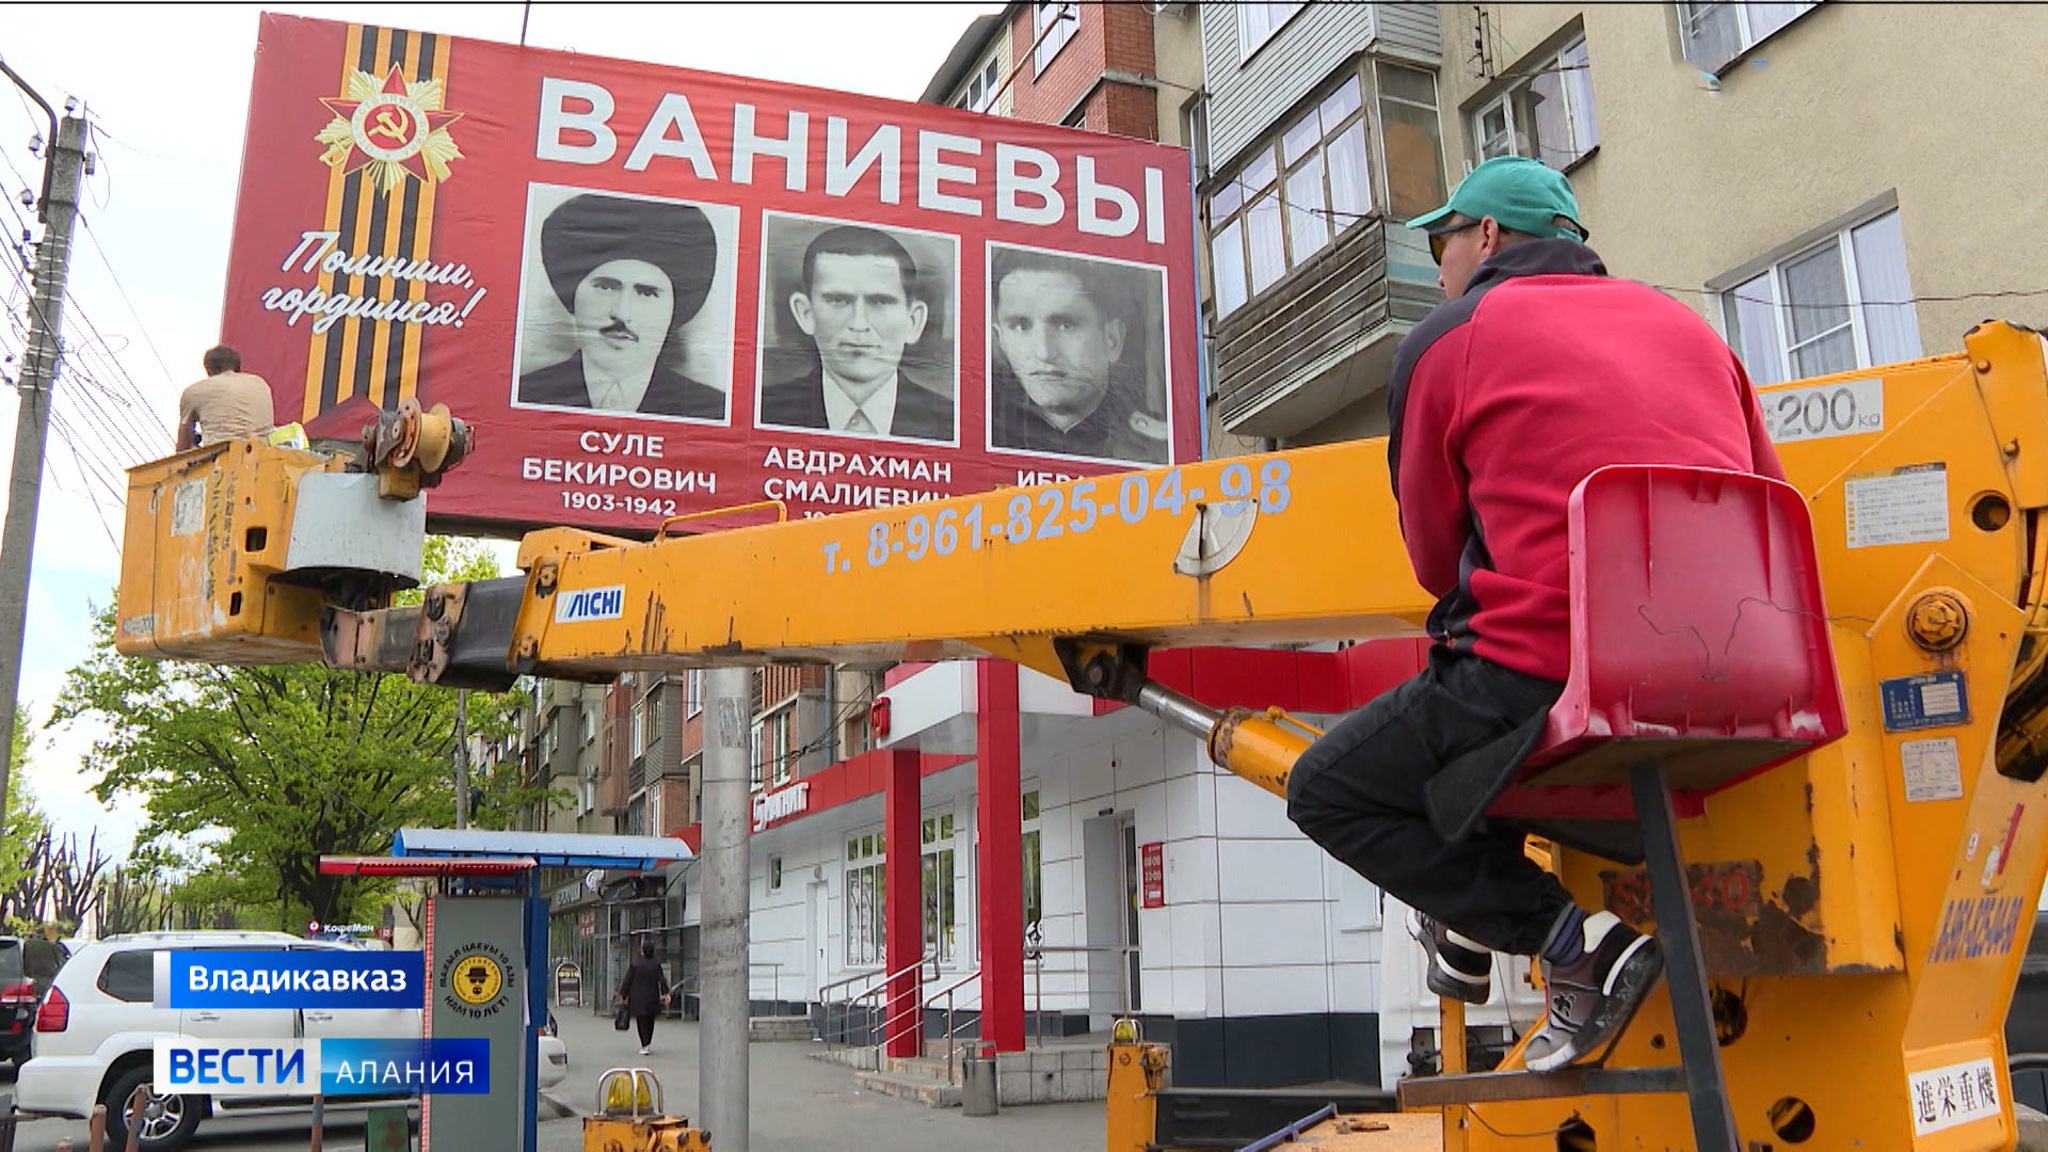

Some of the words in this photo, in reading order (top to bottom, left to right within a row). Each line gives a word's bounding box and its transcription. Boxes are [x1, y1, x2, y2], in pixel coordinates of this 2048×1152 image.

[535, 76, 1166, 244] ВАНИЕВЫ
[281, 231, 475, 290] Помним,
[261, 286, 488, 335] гордимся!
[1778, 387, 1856, 438] 200
[579, 431, 664, 458] СУЛЕ
[522, 457, 717, 494] БЕКИРОВИЧ
[763, 446, 952, 484] АВДРАХМАН
[562, 491, 677, 517] 1903-1942
[567, 590, 622, 618] AICHI
